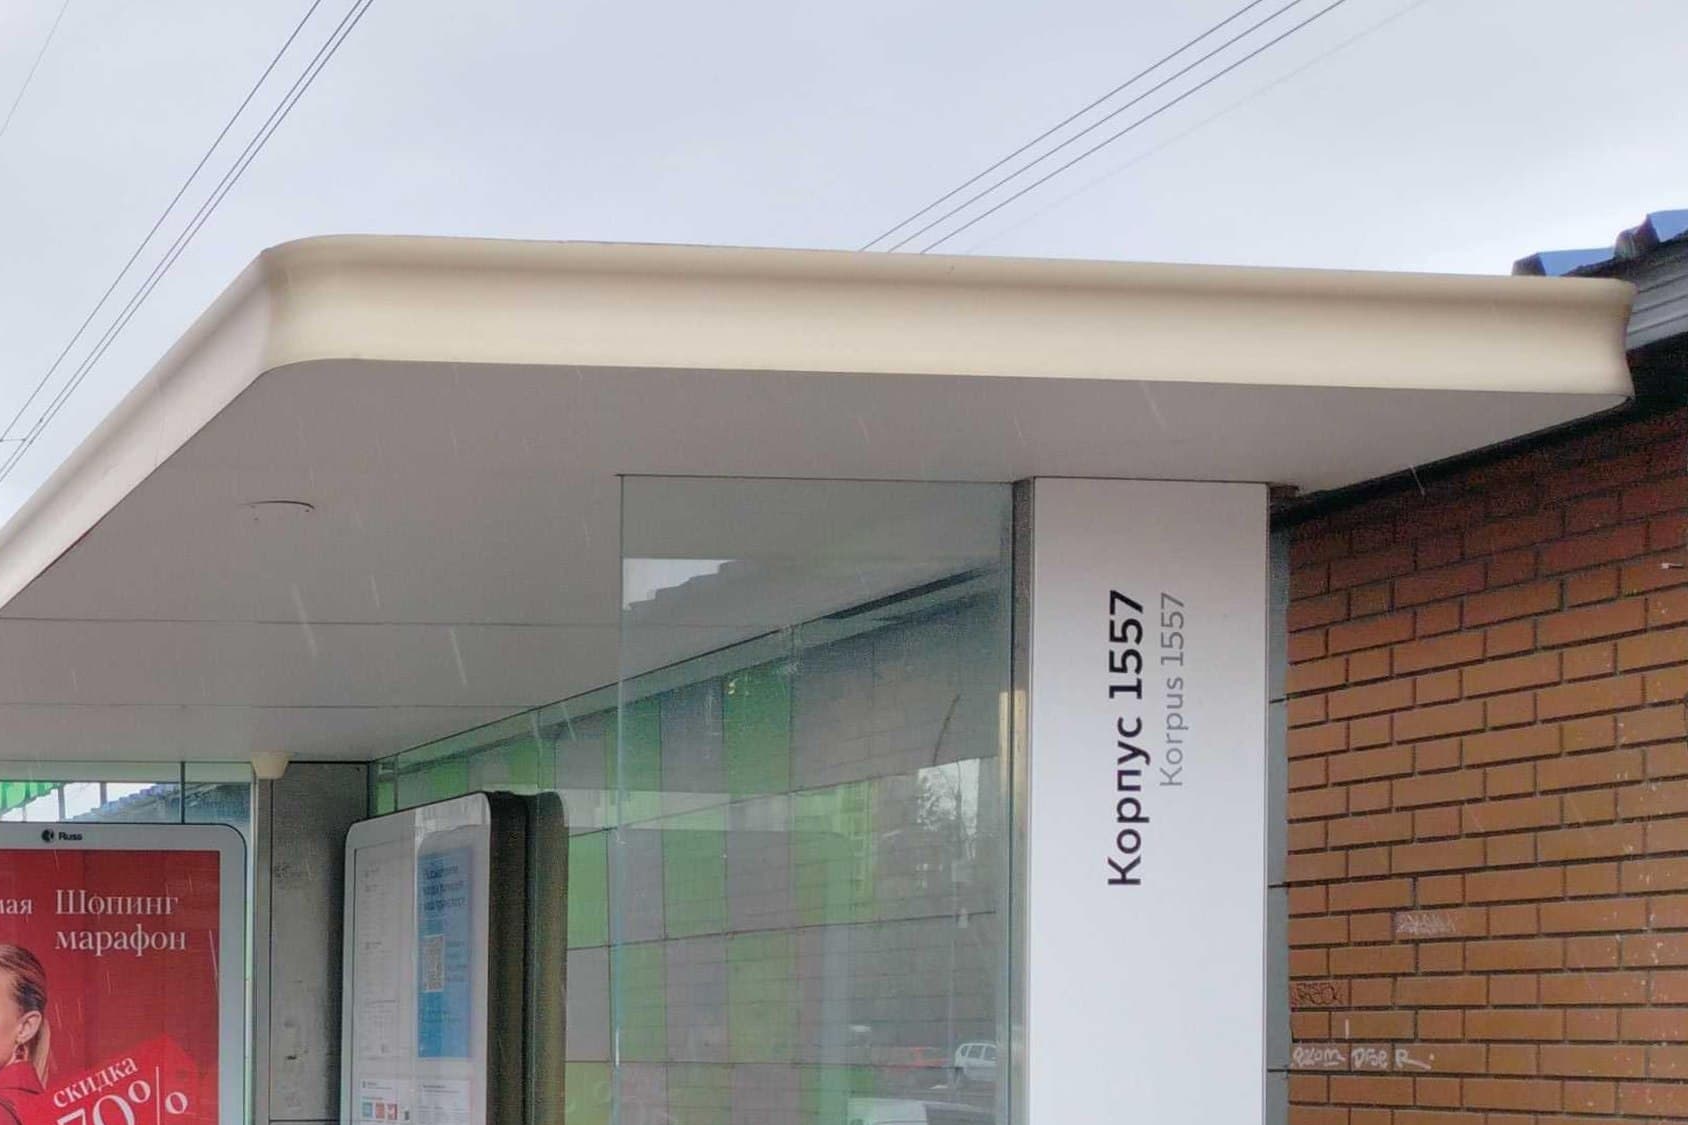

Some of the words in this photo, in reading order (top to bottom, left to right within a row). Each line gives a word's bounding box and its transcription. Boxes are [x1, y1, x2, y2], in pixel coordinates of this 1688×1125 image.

[1109, 589, 1144, 700] 1557
[1160, 591, 1185, 667] 1557
[1159, 676, 1189, 787] Korpus
[1107, 716, 1151, 886] Корпус
[55, 889, 179, 916] Шопинг
[55, 923, 187, 957] марафон
[53, 1057, 138, 1109] скидка
